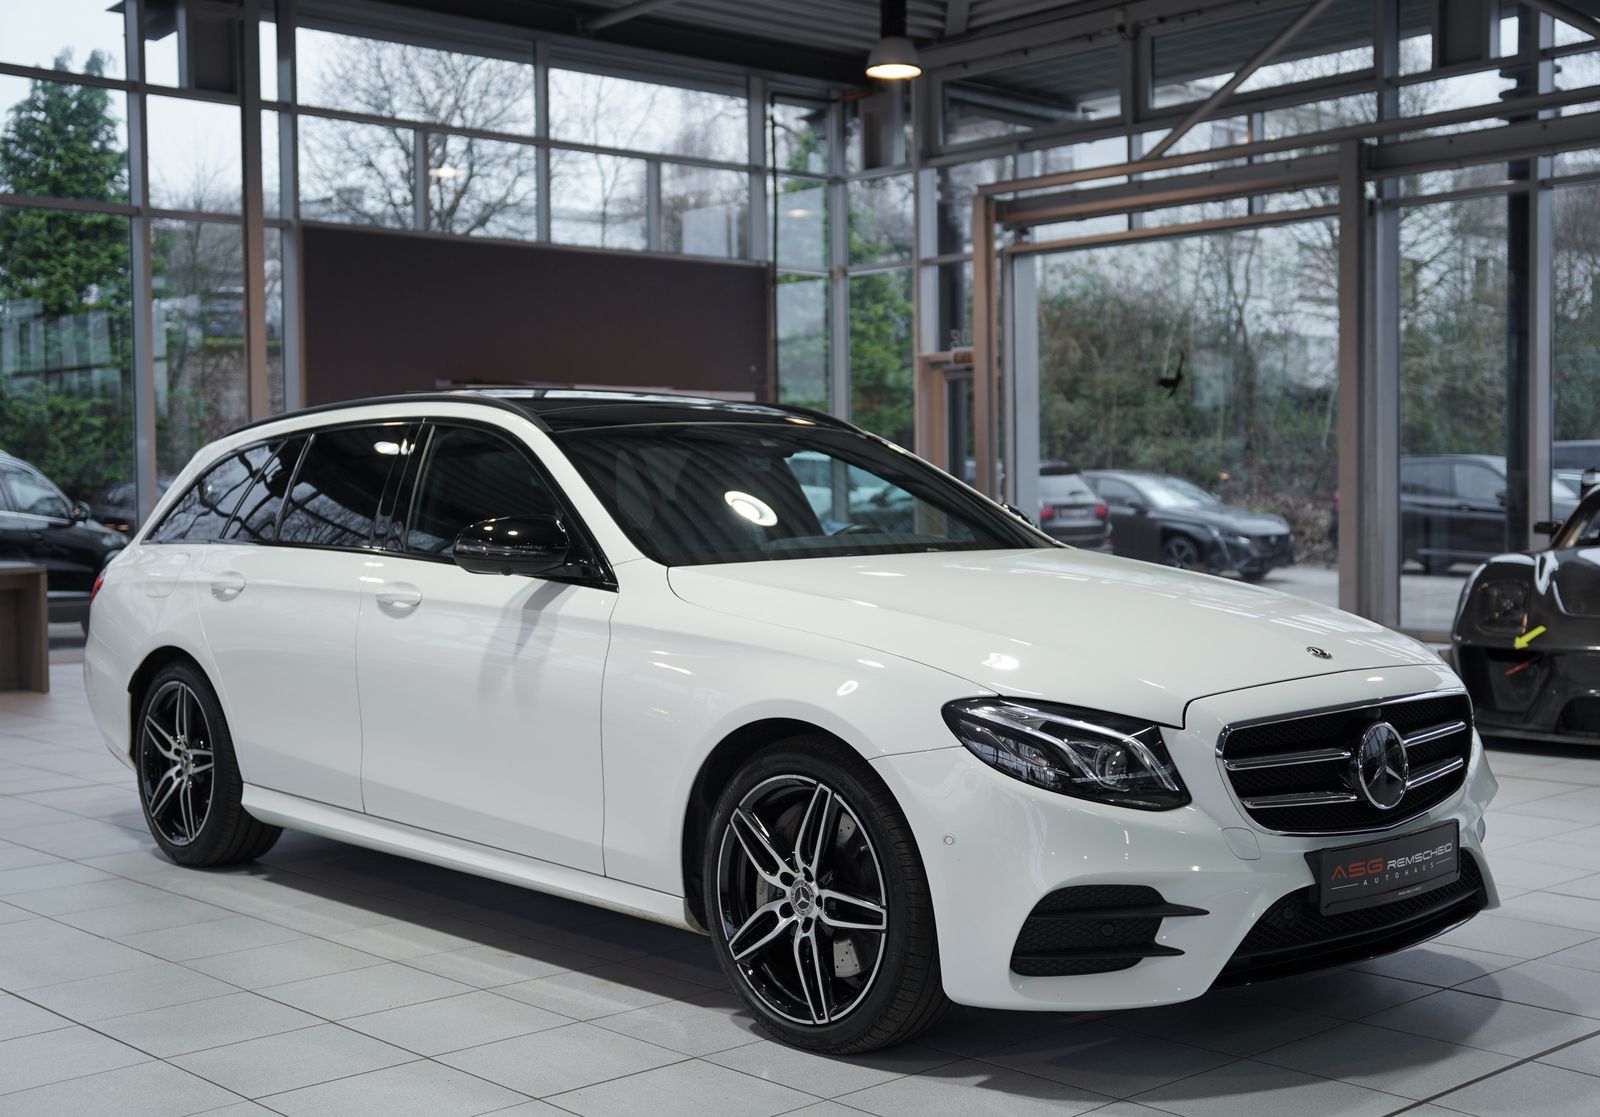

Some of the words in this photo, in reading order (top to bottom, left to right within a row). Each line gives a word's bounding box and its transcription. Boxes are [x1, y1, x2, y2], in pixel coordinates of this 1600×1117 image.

[1331, 857, 1384, 881] ASG
[1387, 843, 1453, 870] REMSCHEID
[1363, 862, 1435, 886] AUTOHAUS
